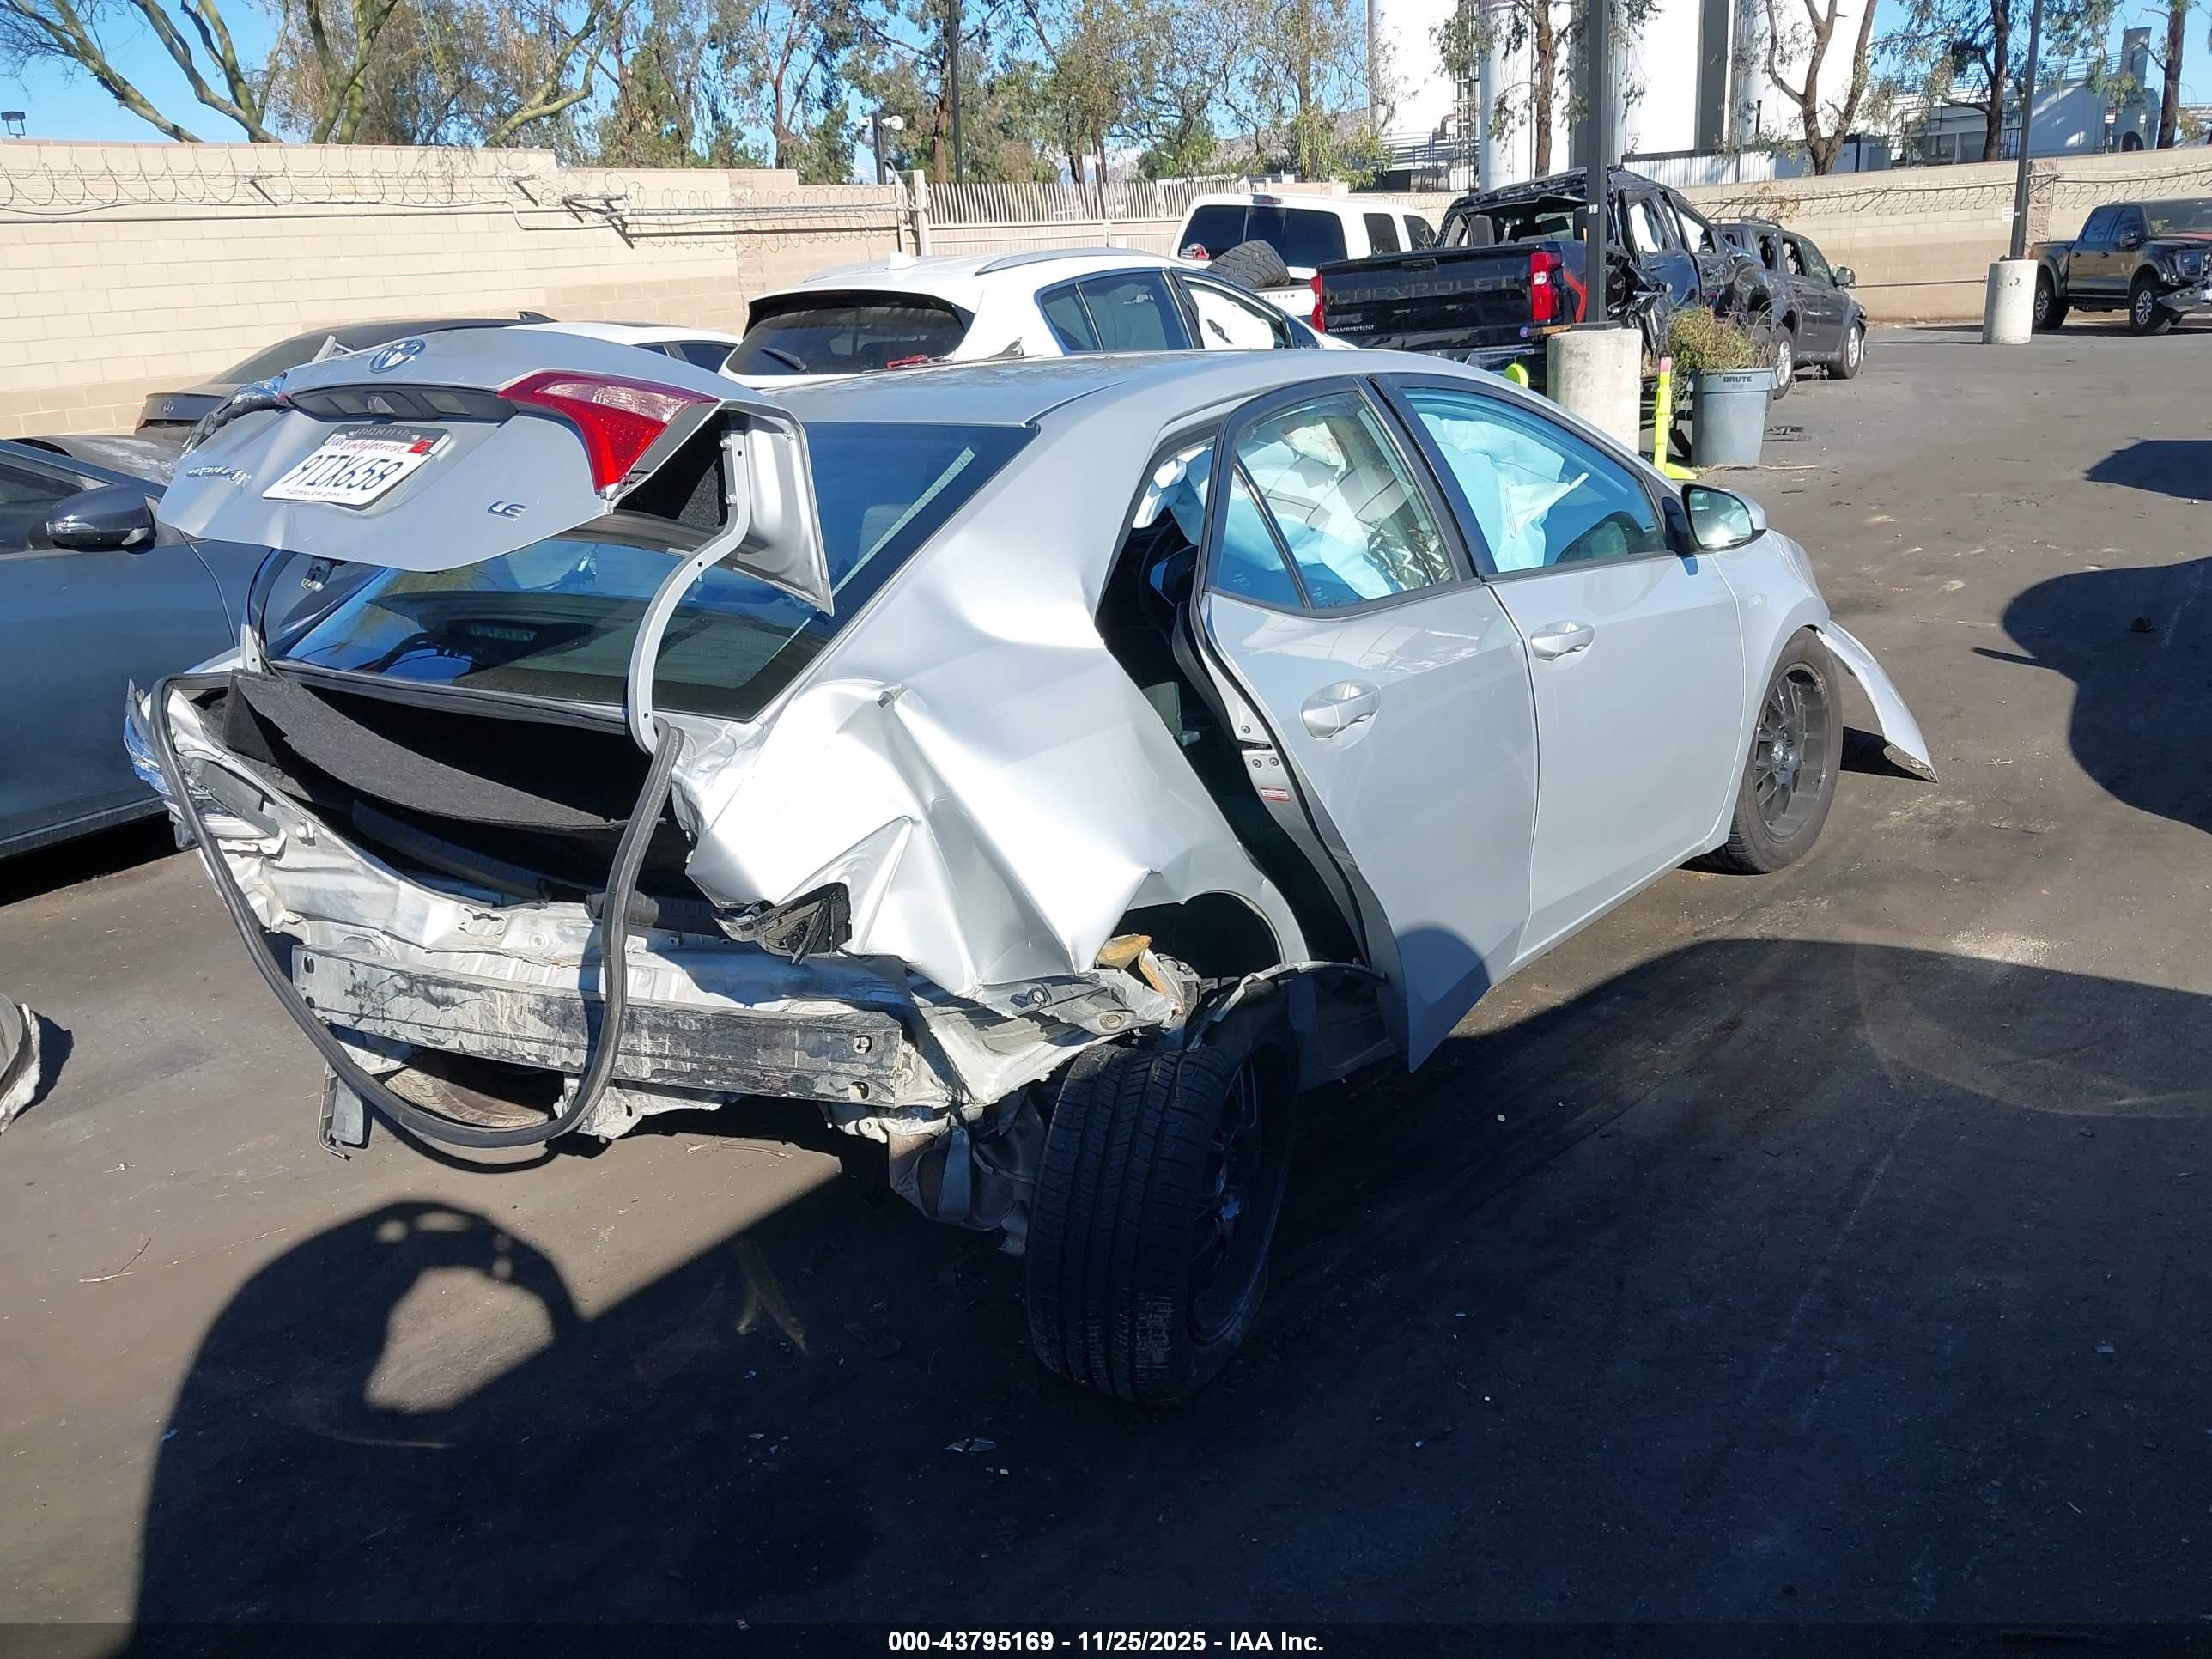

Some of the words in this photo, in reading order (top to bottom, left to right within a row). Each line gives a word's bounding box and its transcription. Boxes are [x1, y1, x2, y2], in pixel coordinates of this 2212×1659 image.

[1631, 137, 1639, 149] 2
[280, 454, 404, 491] 9TIX658
[487, 501, 527, 519] LE
